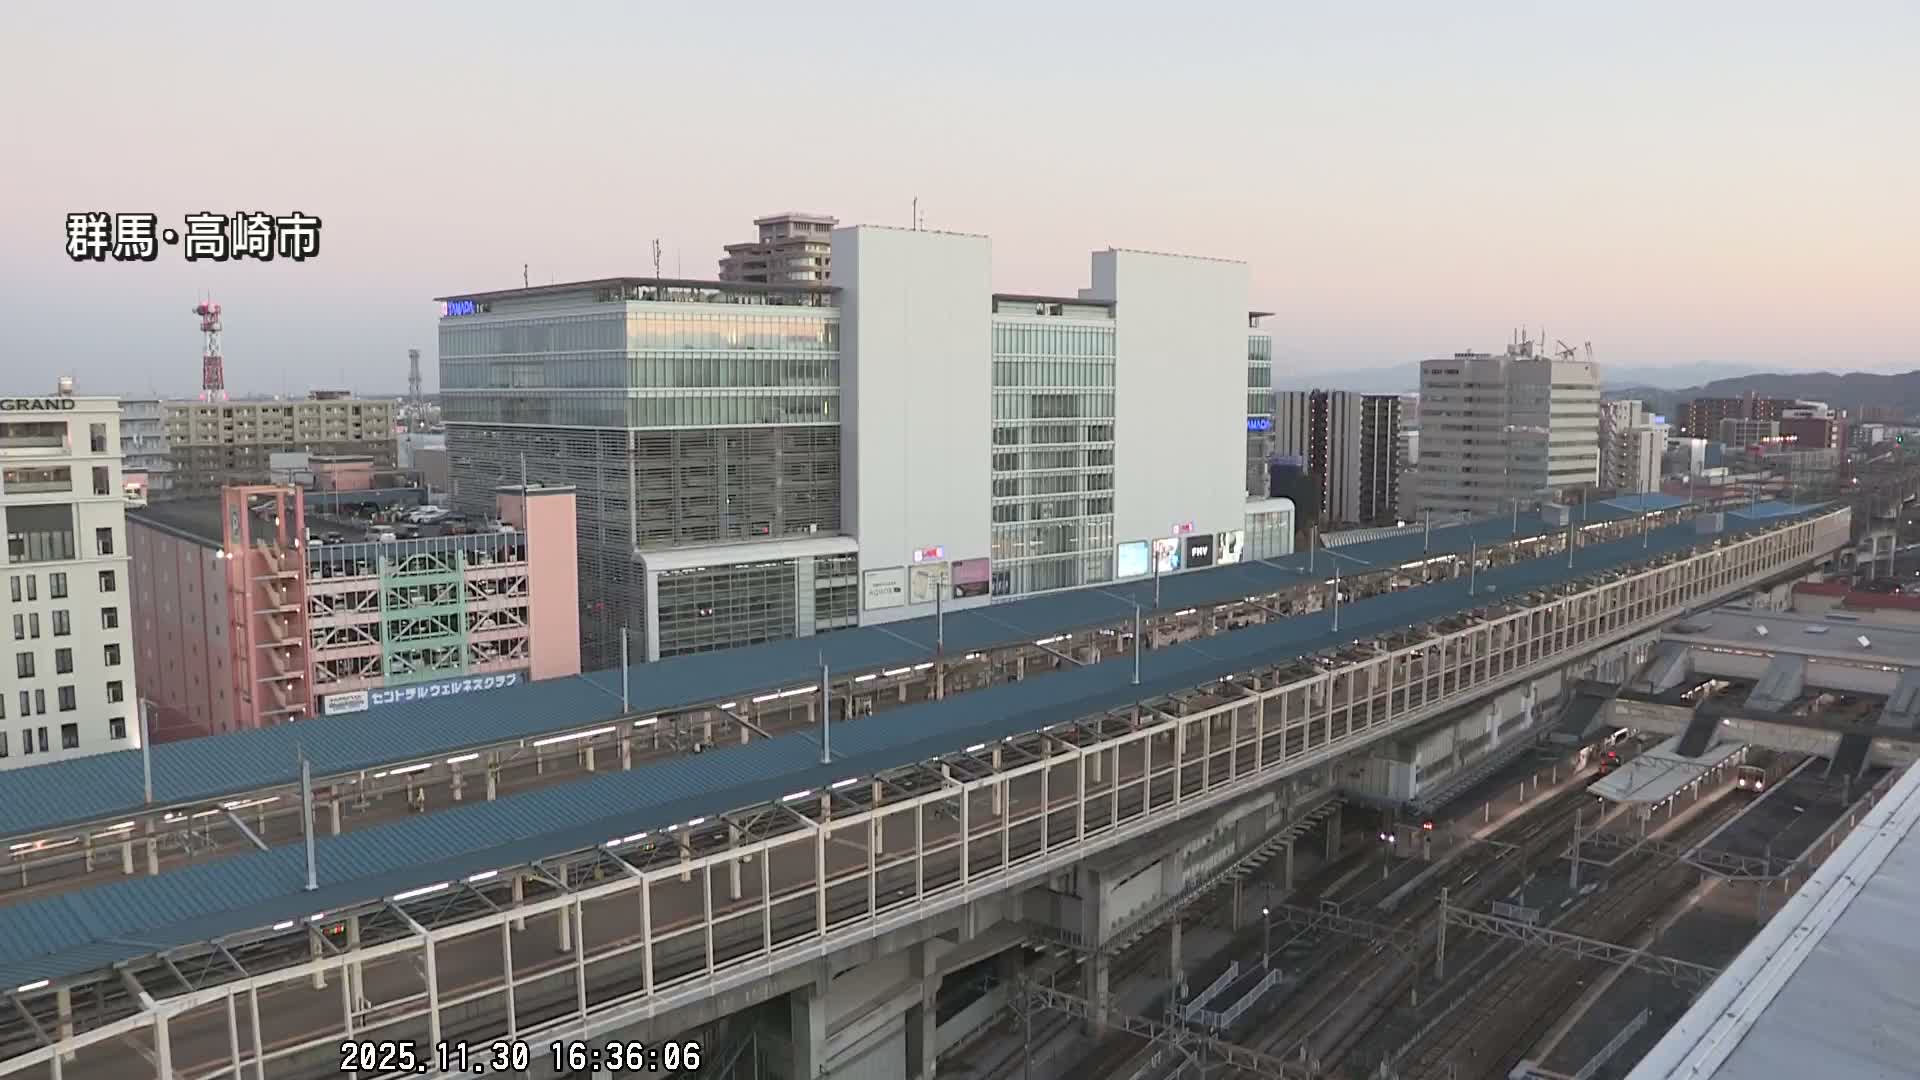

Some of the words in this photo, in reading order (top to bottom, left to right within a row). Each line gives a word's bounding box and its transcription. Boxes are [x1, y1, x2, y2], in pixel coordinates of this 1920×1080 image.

[0, 399, 76, 411] GRAND
[371, 673, 517, 705] セントラルウェルネスクラブ
